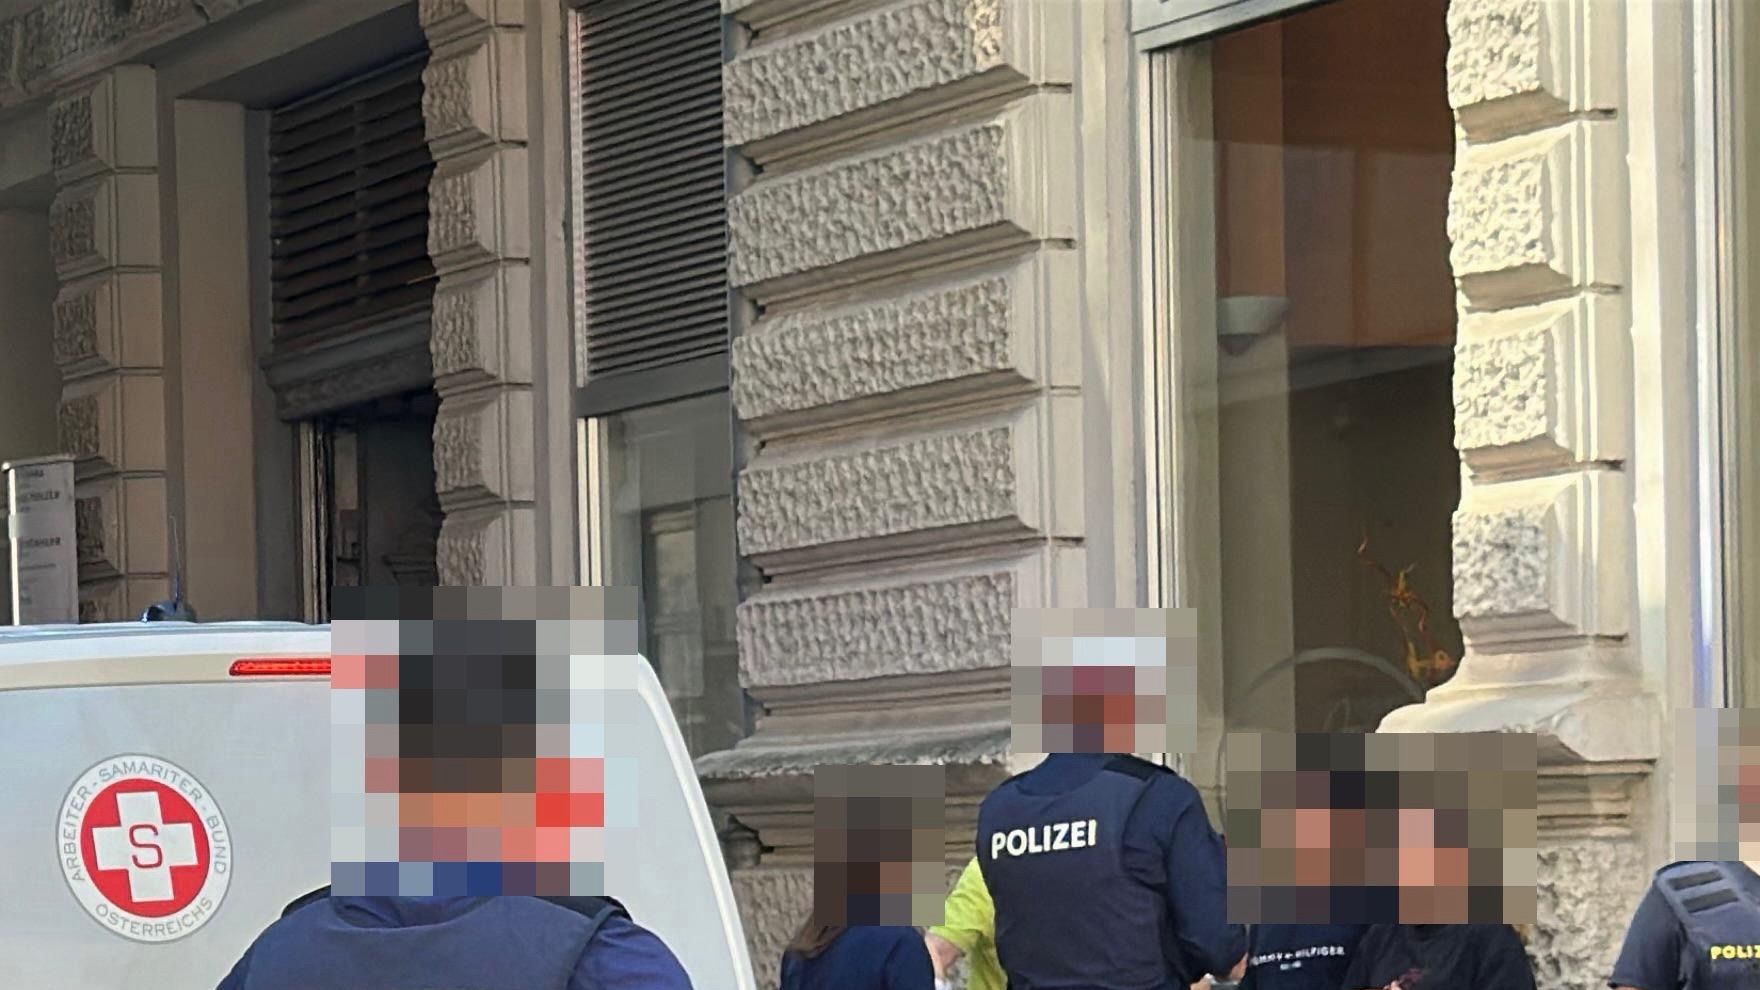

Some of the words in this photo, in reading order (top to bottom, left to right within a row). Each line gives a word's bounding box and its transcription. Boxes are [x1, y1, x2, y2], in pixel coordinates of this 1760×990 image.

[98, 760, 203, 804] SAMARITER
[63, 784, 93, 883] ARBEITER
[129, 823, 163, 869] S
[206, 815, 228, 876] BUND
[991, 819, 1097, 860] POLIZEI
[95, 895, 214, 938] ÖSTERREICHS
